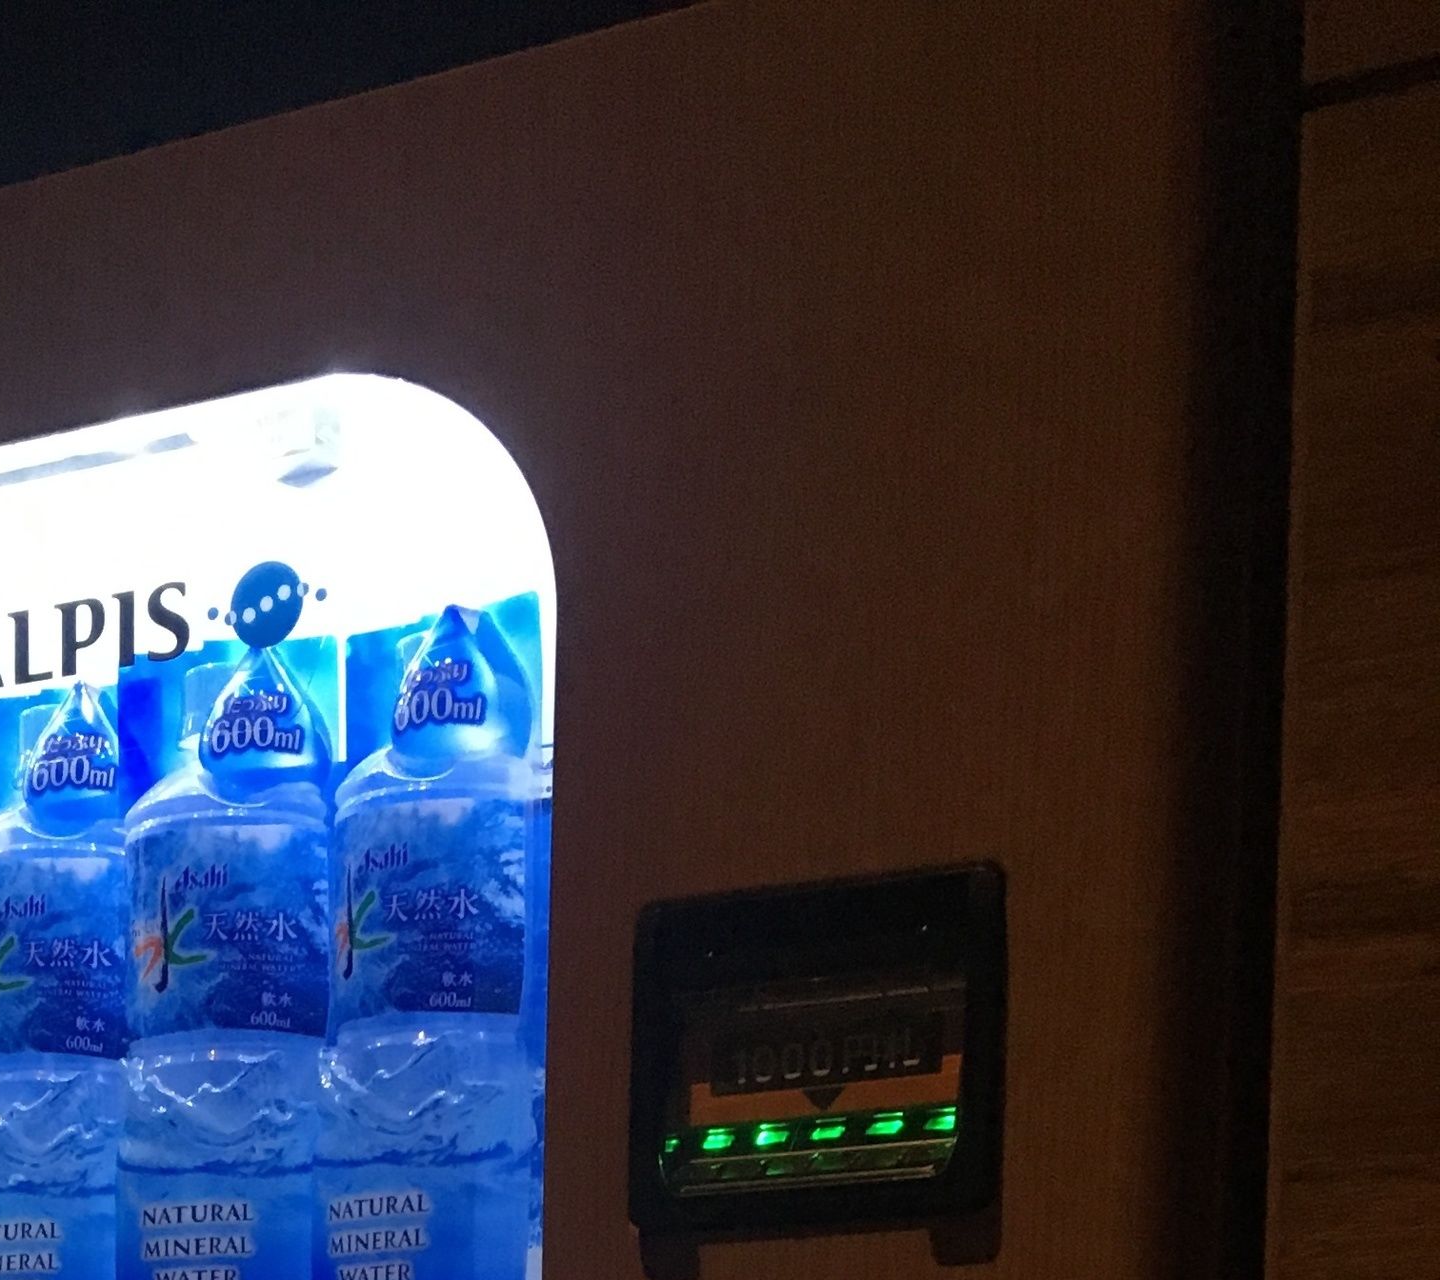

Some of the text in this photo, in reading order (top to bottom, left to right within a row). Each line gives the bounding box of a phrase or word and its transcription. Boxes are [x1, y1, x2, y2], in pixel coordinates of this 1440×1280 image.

[396, 690, 482, 731] 600ml
[211, 718, 301, 754] 600ml
[32, 758, 115, 791] 600ml
[385, 888, 480, 923] 天然水
[203, 911, 298, 942] 天然水
[23, 937, 113, 969] 天然水
[141, 1203, 253, 1226] NATURAL
[328, 1194, 429, 1221] NATURAL
[144, 1236, 252, 1259] MINERAL
[330, 1228, 427, 1254] MINERAL
